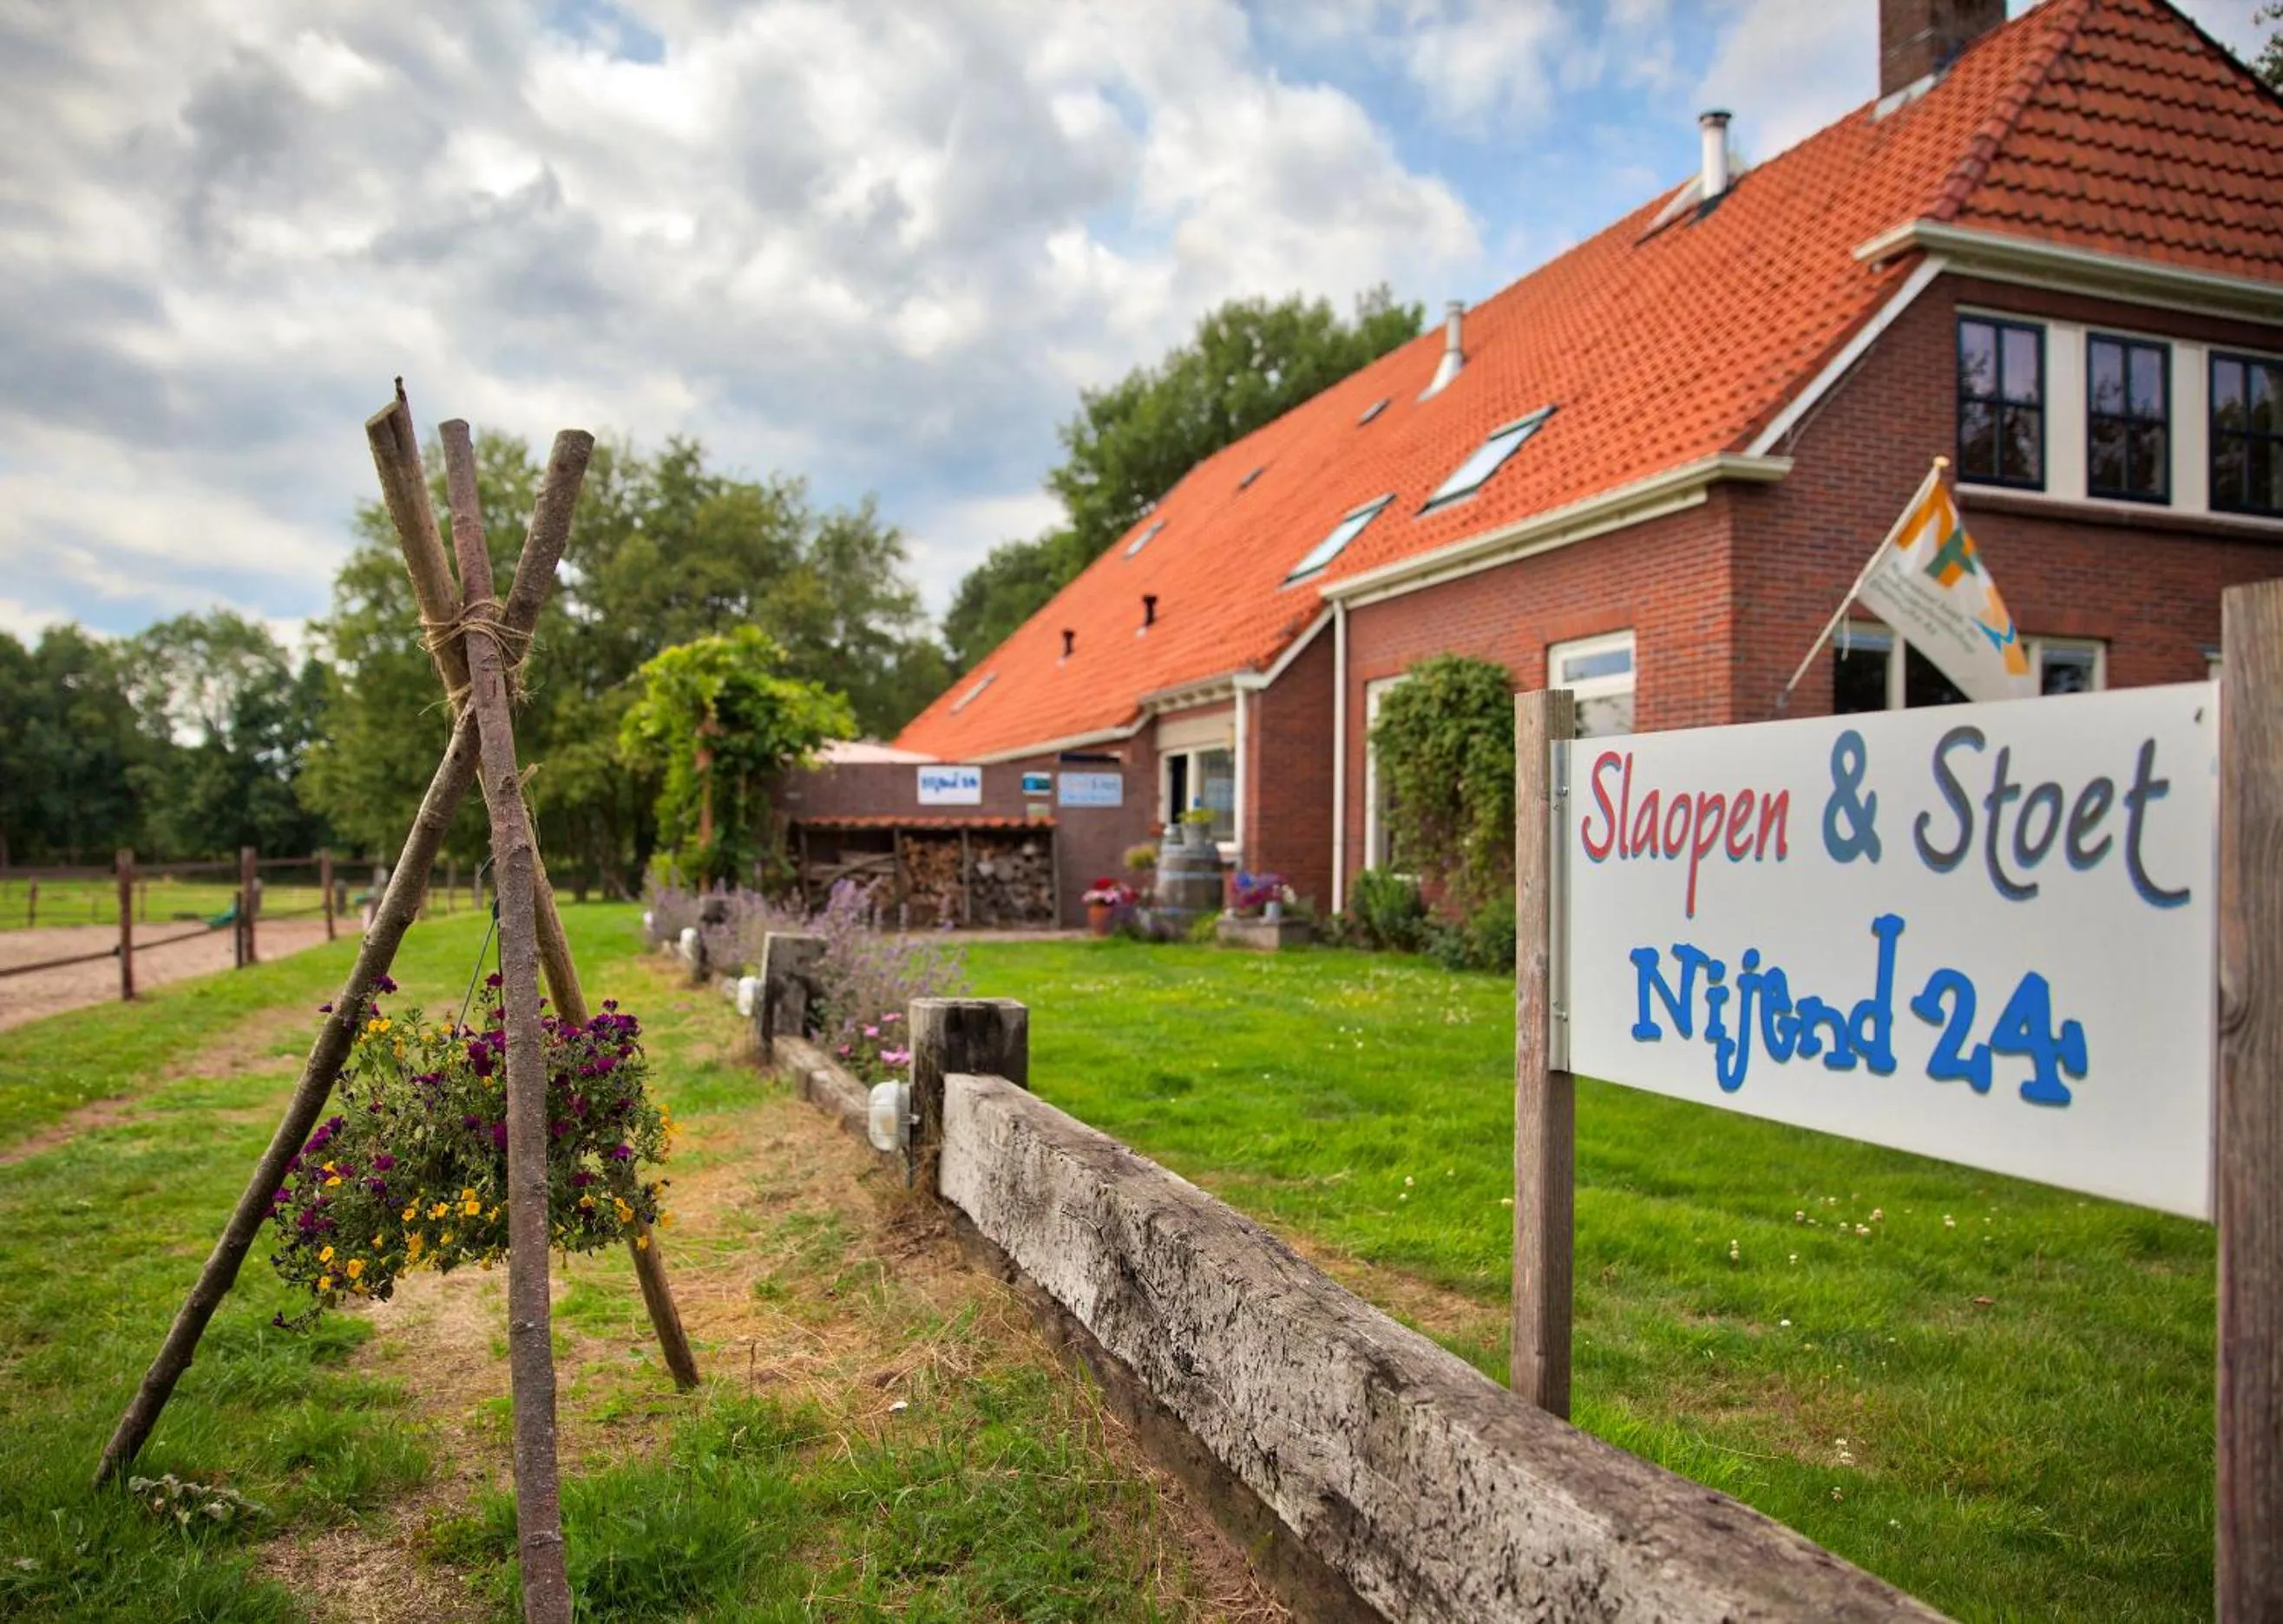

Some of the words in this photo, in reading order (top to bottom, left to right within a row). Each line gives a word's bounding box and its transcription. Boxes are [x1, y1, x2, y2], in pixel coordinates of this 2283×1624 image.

[1580, 750, 1790, 918] Slaopen
[1821, 729, 1882, 864] &
[1912, 725, 2191, 908] Stoet
[1630, 913, 1906, 1092] Nijend
[1911, 967, 2089, 1107] 24
